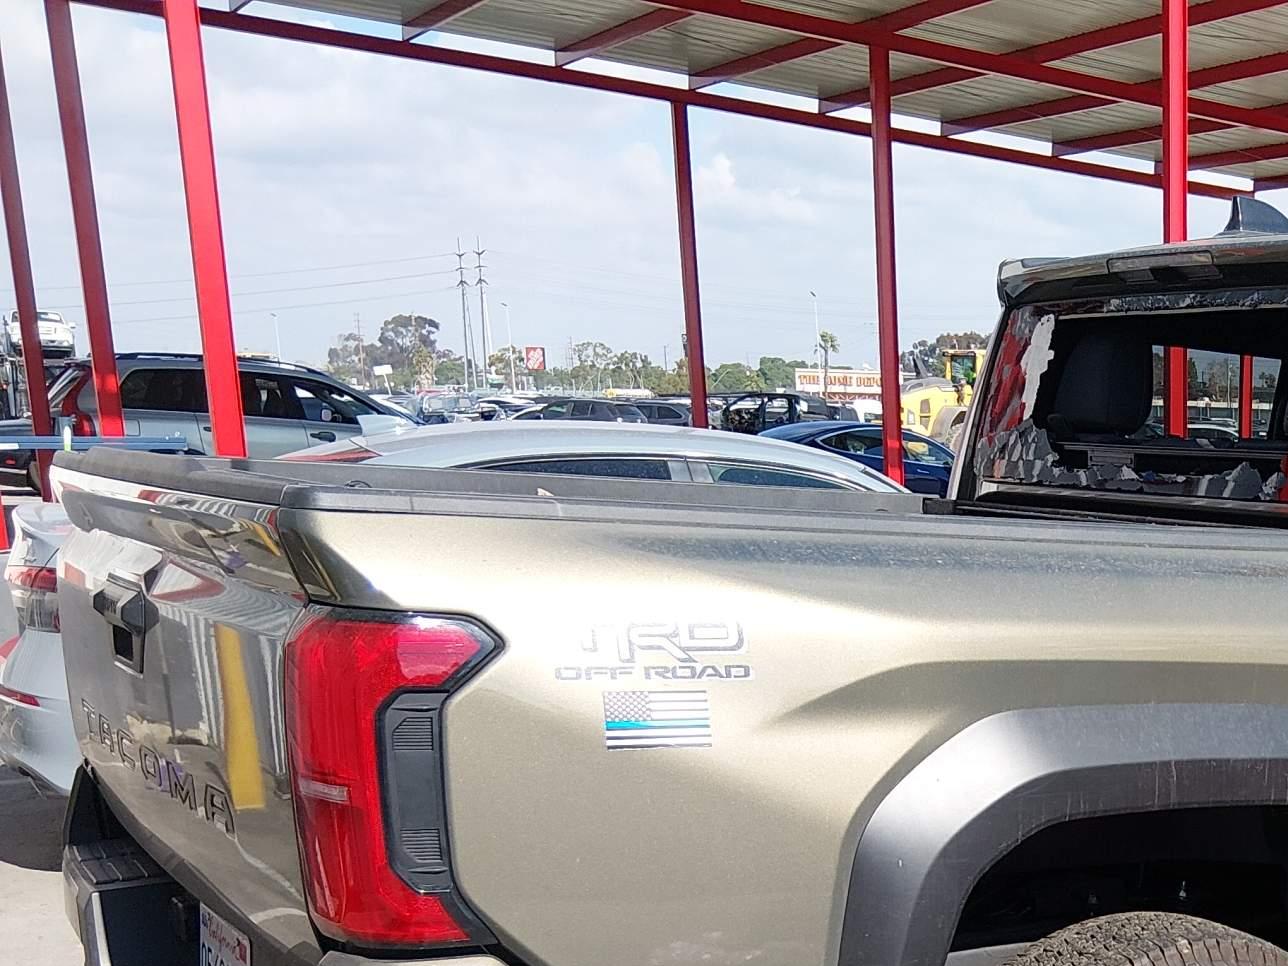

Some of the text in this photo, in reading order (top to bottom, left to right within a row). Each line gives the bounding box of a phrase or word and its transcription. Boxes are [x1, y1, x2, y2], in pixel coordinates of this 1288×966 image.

[579, 621, 745, 663] TRD
[555, 664, 751, 680] OFF ROAD
[81, 698, 236, 834] TACOMA
